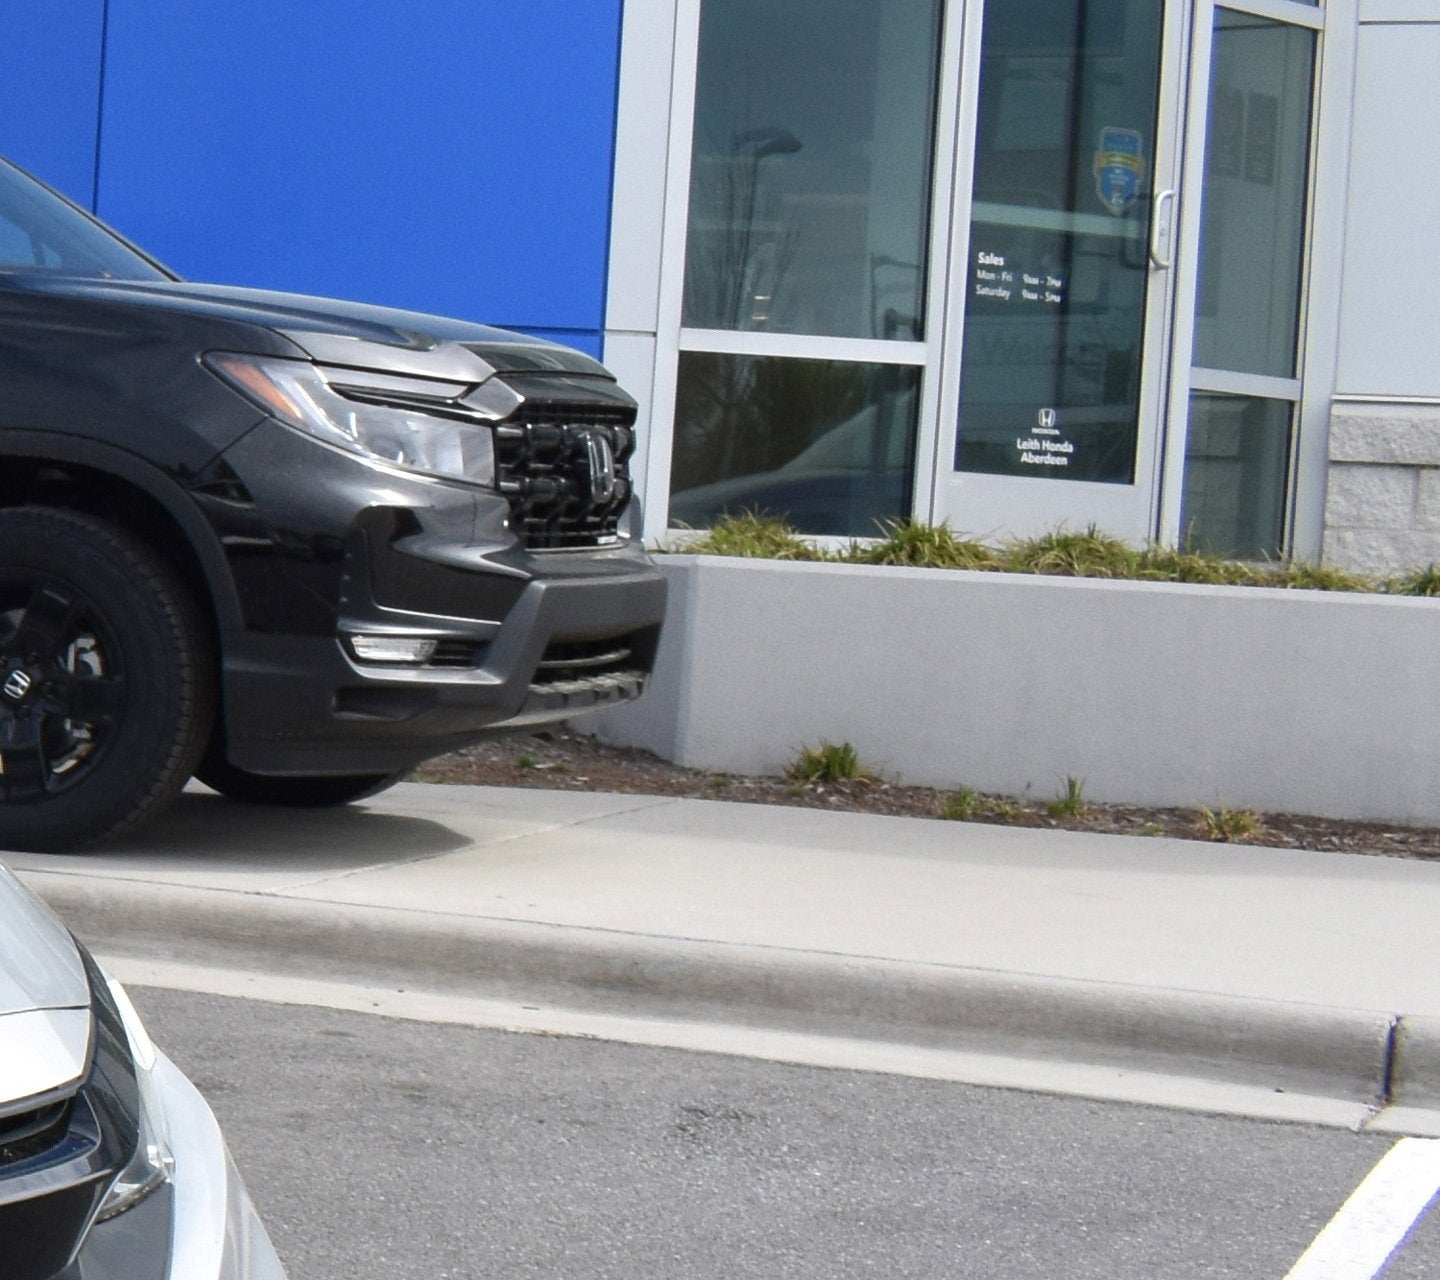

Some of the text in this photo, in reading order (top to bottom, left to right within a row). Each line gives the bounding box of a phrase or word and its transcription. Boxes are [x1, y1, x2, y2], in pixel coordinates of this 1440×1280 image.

[977, 251, 1004, 266] Sales
[975, 284, 1011, 300] Saturday
[1016, 438, 1074, 453] Leith Honda
[1020, 451, 1068, 465] Aberdeen
